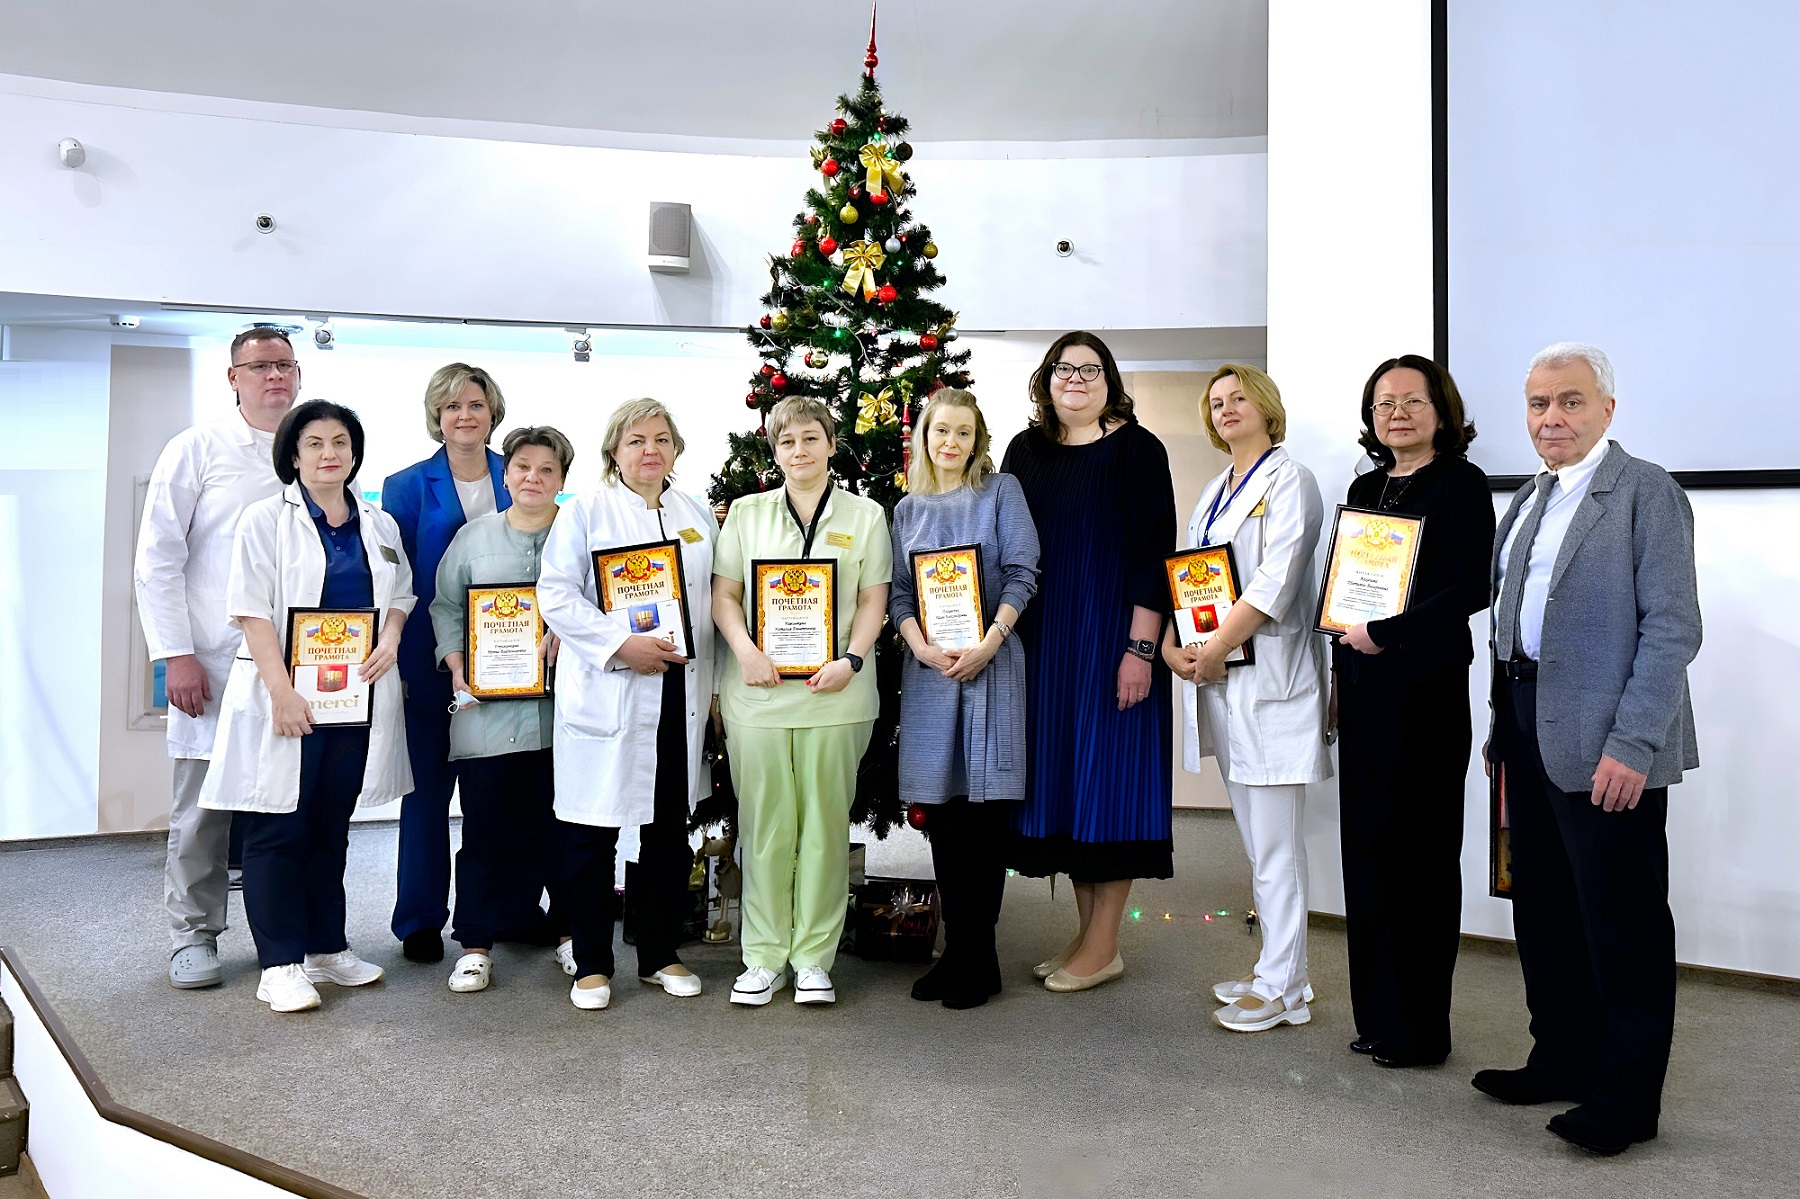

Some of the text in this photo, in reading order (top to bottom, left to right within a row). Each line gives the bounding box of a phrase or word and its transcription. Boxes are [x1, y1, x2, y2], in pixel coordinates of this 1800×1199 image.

[617, 580, 665, 594] ПОЧЕТНАЯ
[929, 584, 968, 594] ПОЧЕТНАЯ
[1183, 585, 1223, 598] ПОЧЕТНАЯ
[625, 589, 659, 600] ГРАМОТА
[1190, 595, 1219, 603] ГРАМОТА
[771, 597, 819, 605] ПОЧЕТНАЯ
[483, 620, 530, 629] ПОЧЕТНАЯ
[307, 647, 357, 655] ПОЧЕТНАЯ
